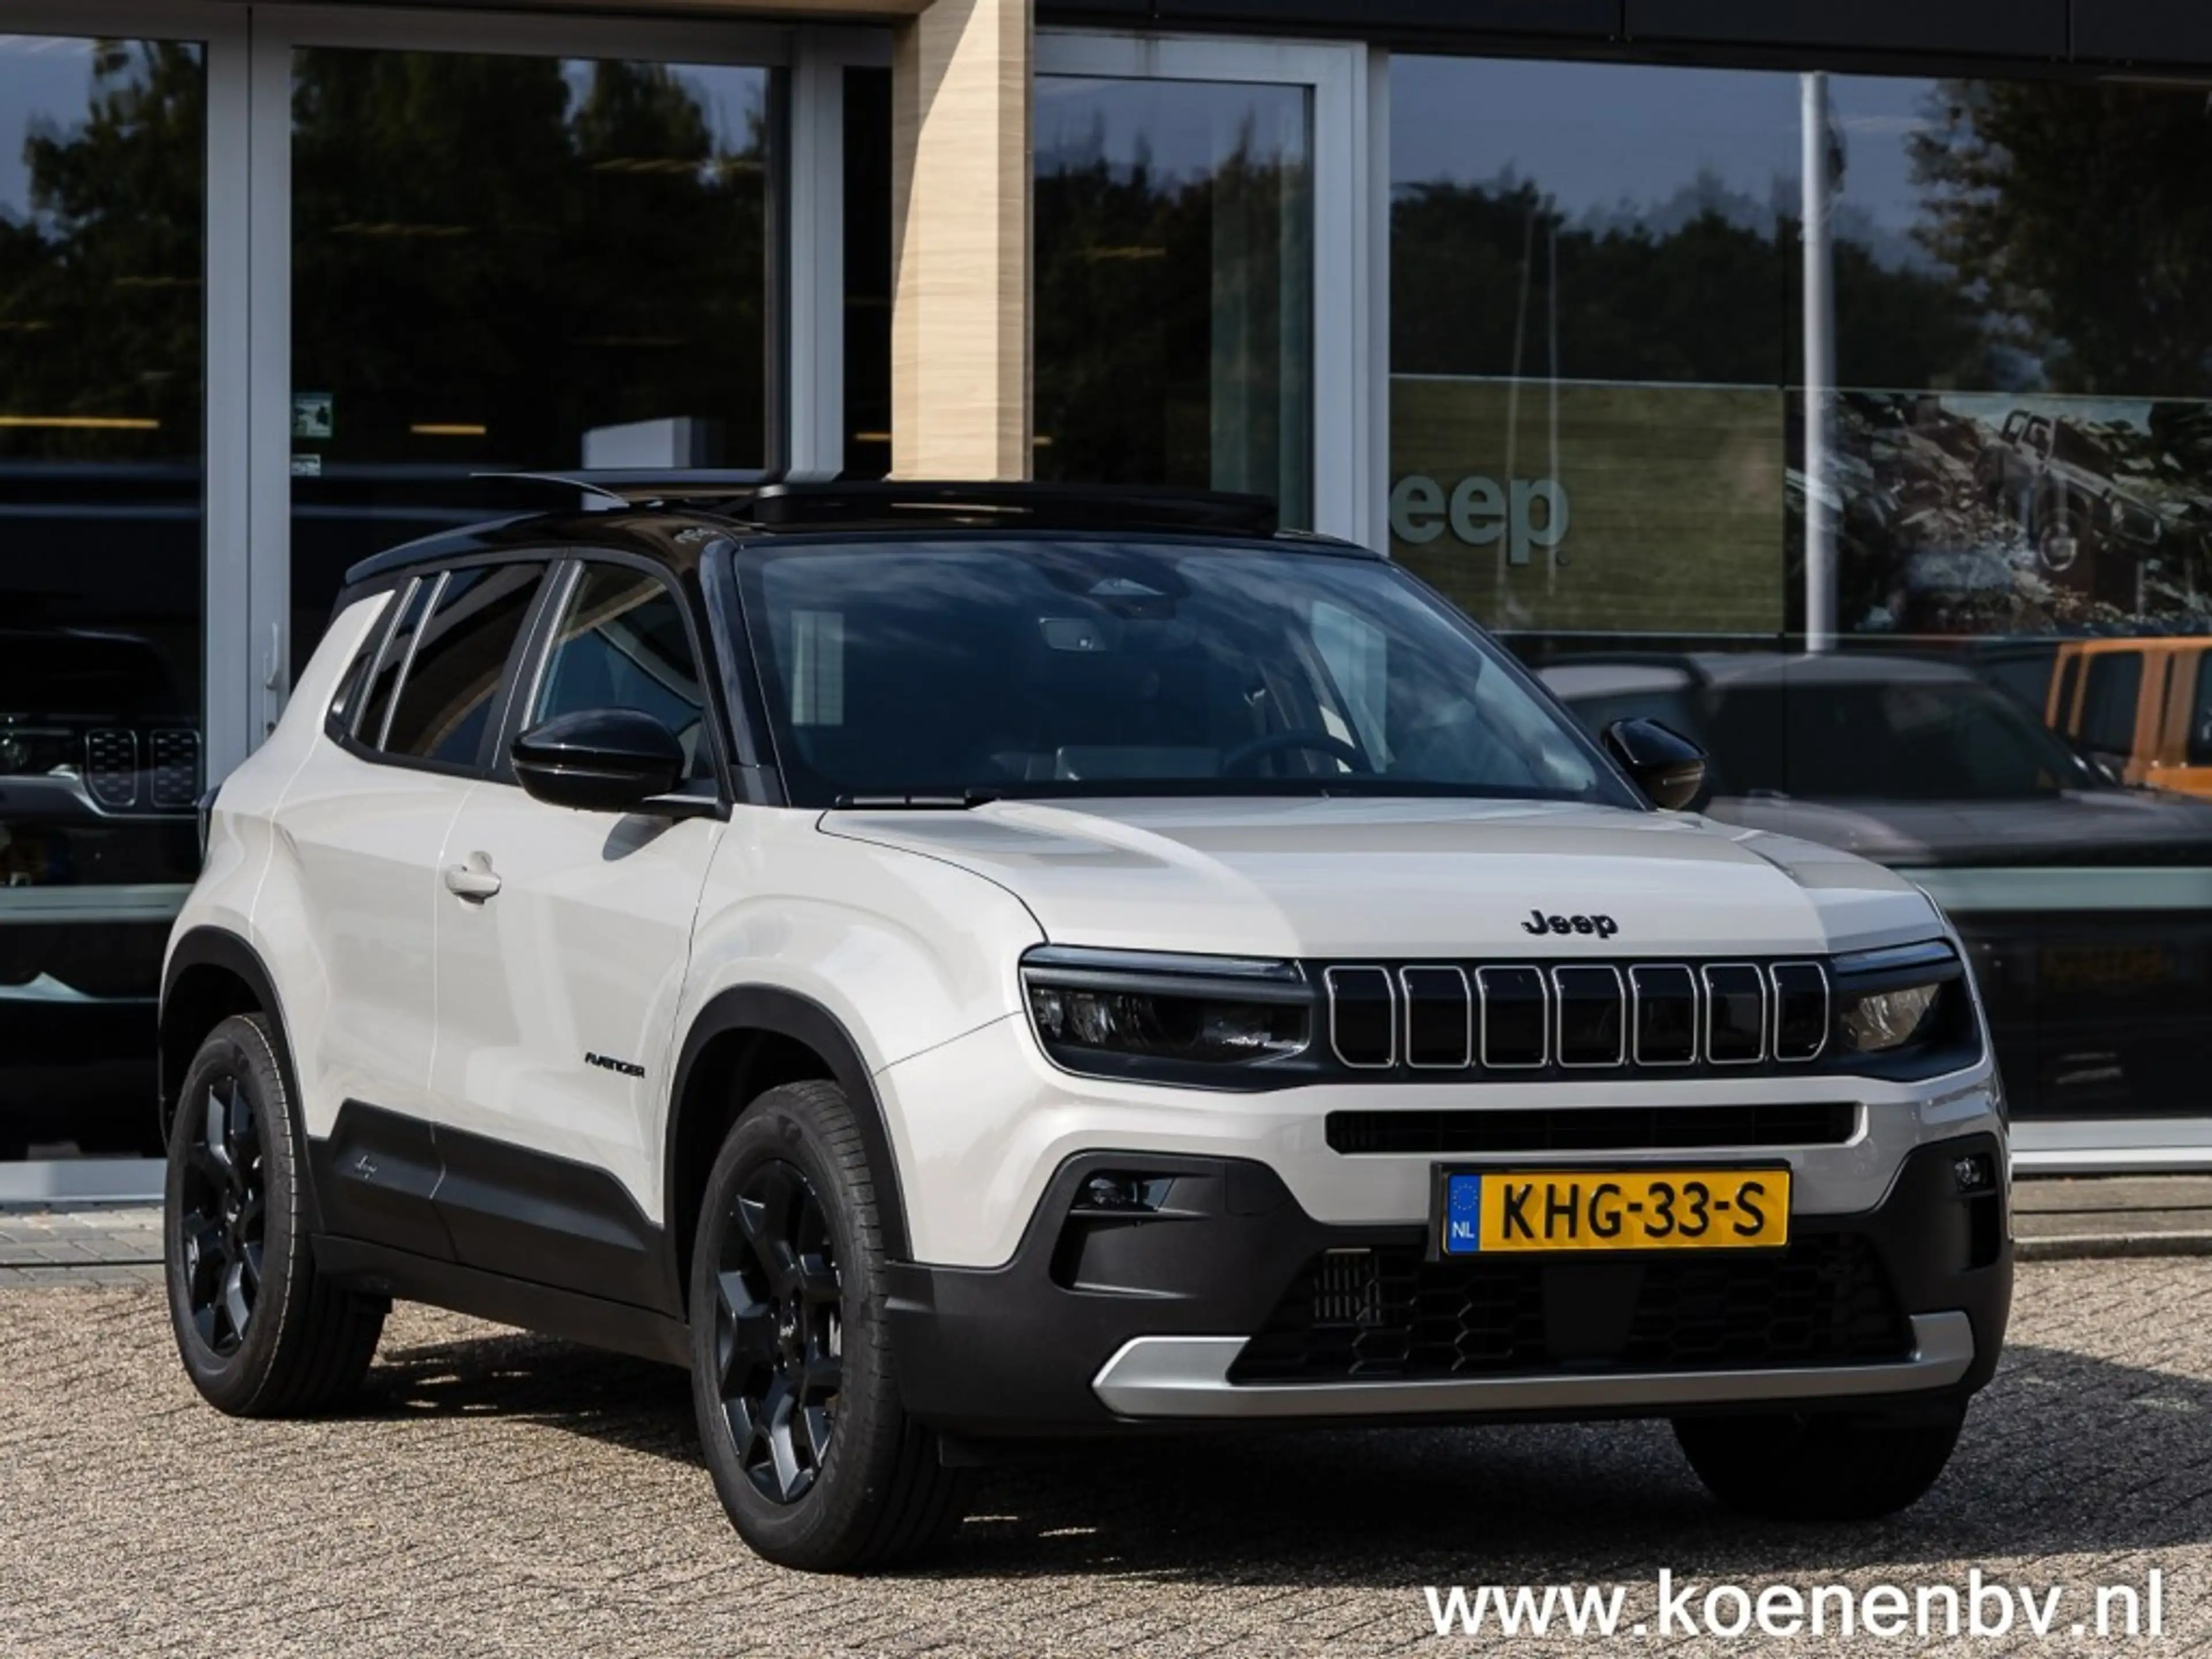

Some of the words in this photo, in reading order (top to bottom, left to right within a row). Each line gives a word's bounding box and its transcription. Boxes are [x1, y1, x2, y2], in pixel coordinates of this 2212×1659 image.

[1391, 475, 1570, 563] eep
[1521, 910, 1619, 940] Jeep
[1452, 1220, 1475, 1239] NL
[1502, 1181, 1765, 1239] KHG-33-S
